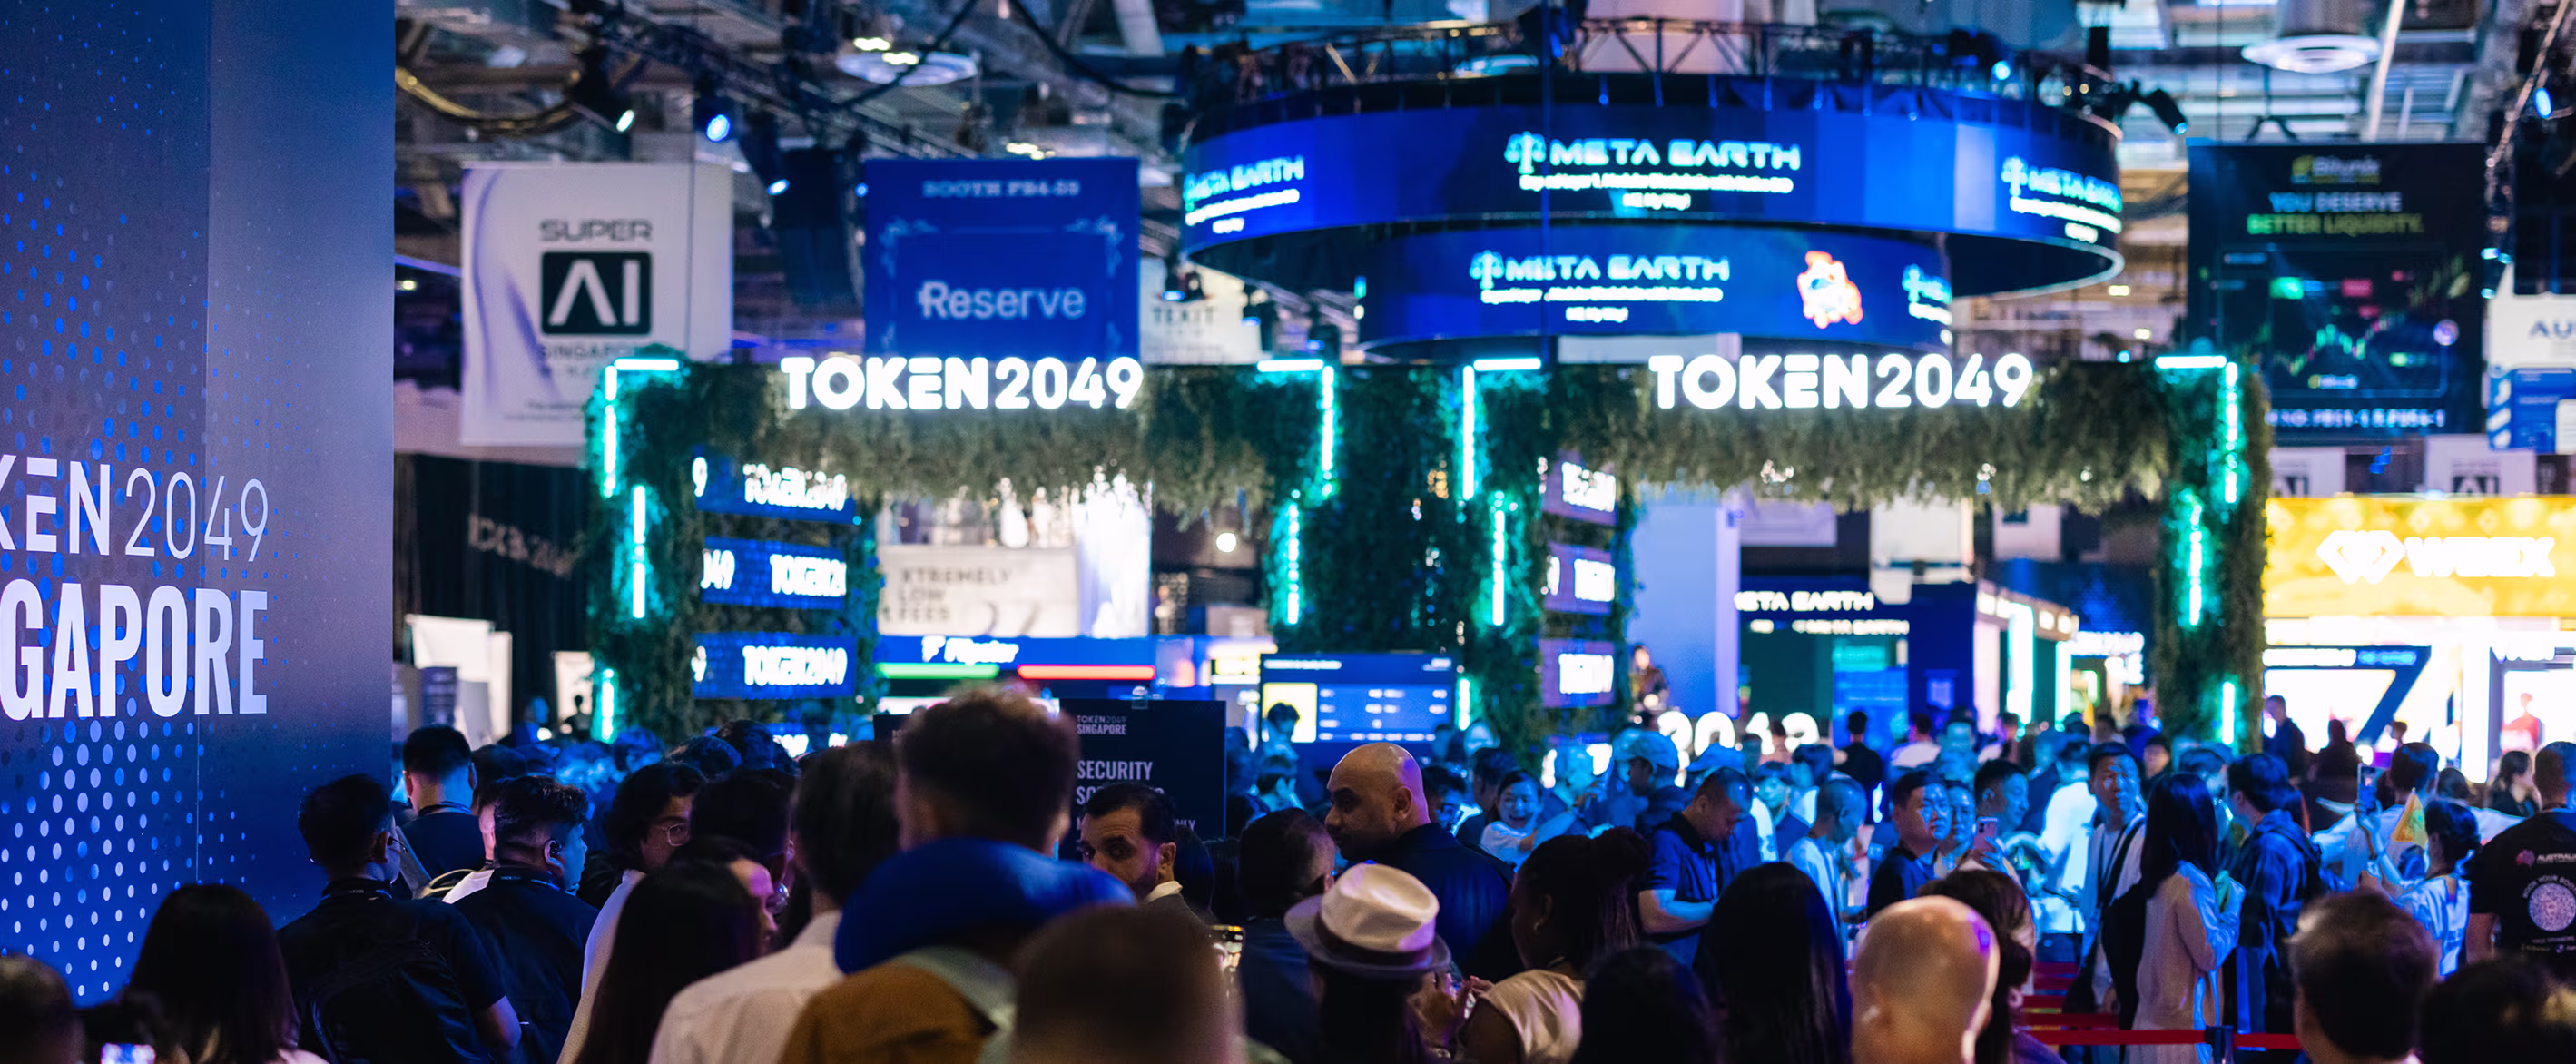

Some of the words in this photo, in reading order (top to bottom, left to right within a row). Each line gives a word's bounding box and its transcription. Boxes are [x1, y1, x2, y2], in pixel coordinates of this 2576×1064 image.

[1549, 138, 1661, 165] META
[1668, 139, 1801, 171] EARTH
[1231, 154, 1304, 191] EARTH
[2269, 192, 2313, 212] YOU
[2315, 192, 2402, 212] DESERVE
[540, 220, 652, 241] SUPER
[2247, 213, 2322, 235] BETTER
[1608, 255, 1730, 281] EARTH
[547, 259, 641, 327] AI
[919, 281, 1084, 319] Reserve
[0, 578, 268, 721] GAPORE
[1077, 724, 1126, 735] SINGAPORE
[1077, 760, 1154, 781] SECURITY
